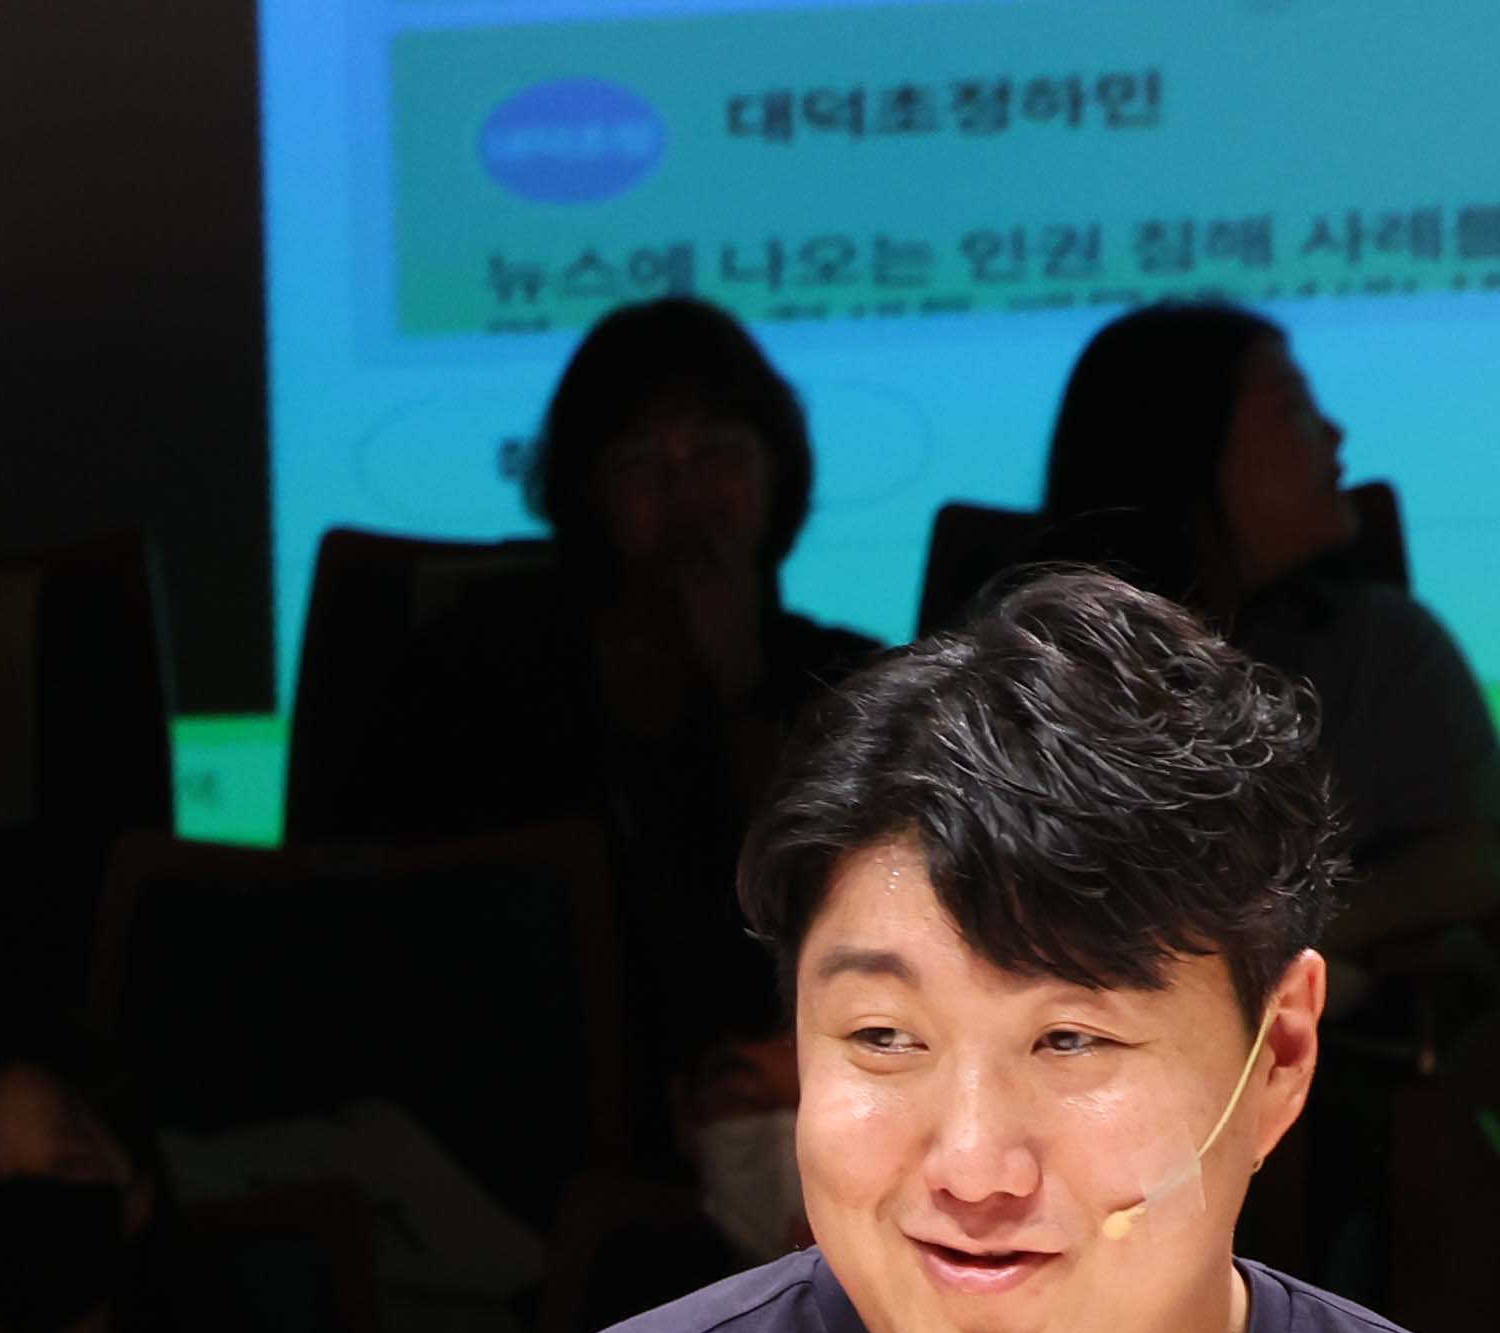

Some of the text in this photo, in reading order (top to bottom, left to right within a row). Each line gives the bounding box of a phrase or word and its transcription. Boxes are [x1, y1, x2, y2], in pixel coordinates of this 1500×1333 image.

[486, 238, 698, 304] 뉴스에
[719, 231, 936, 293] 나오는
[1134, 211, 1276, 275] 침해
